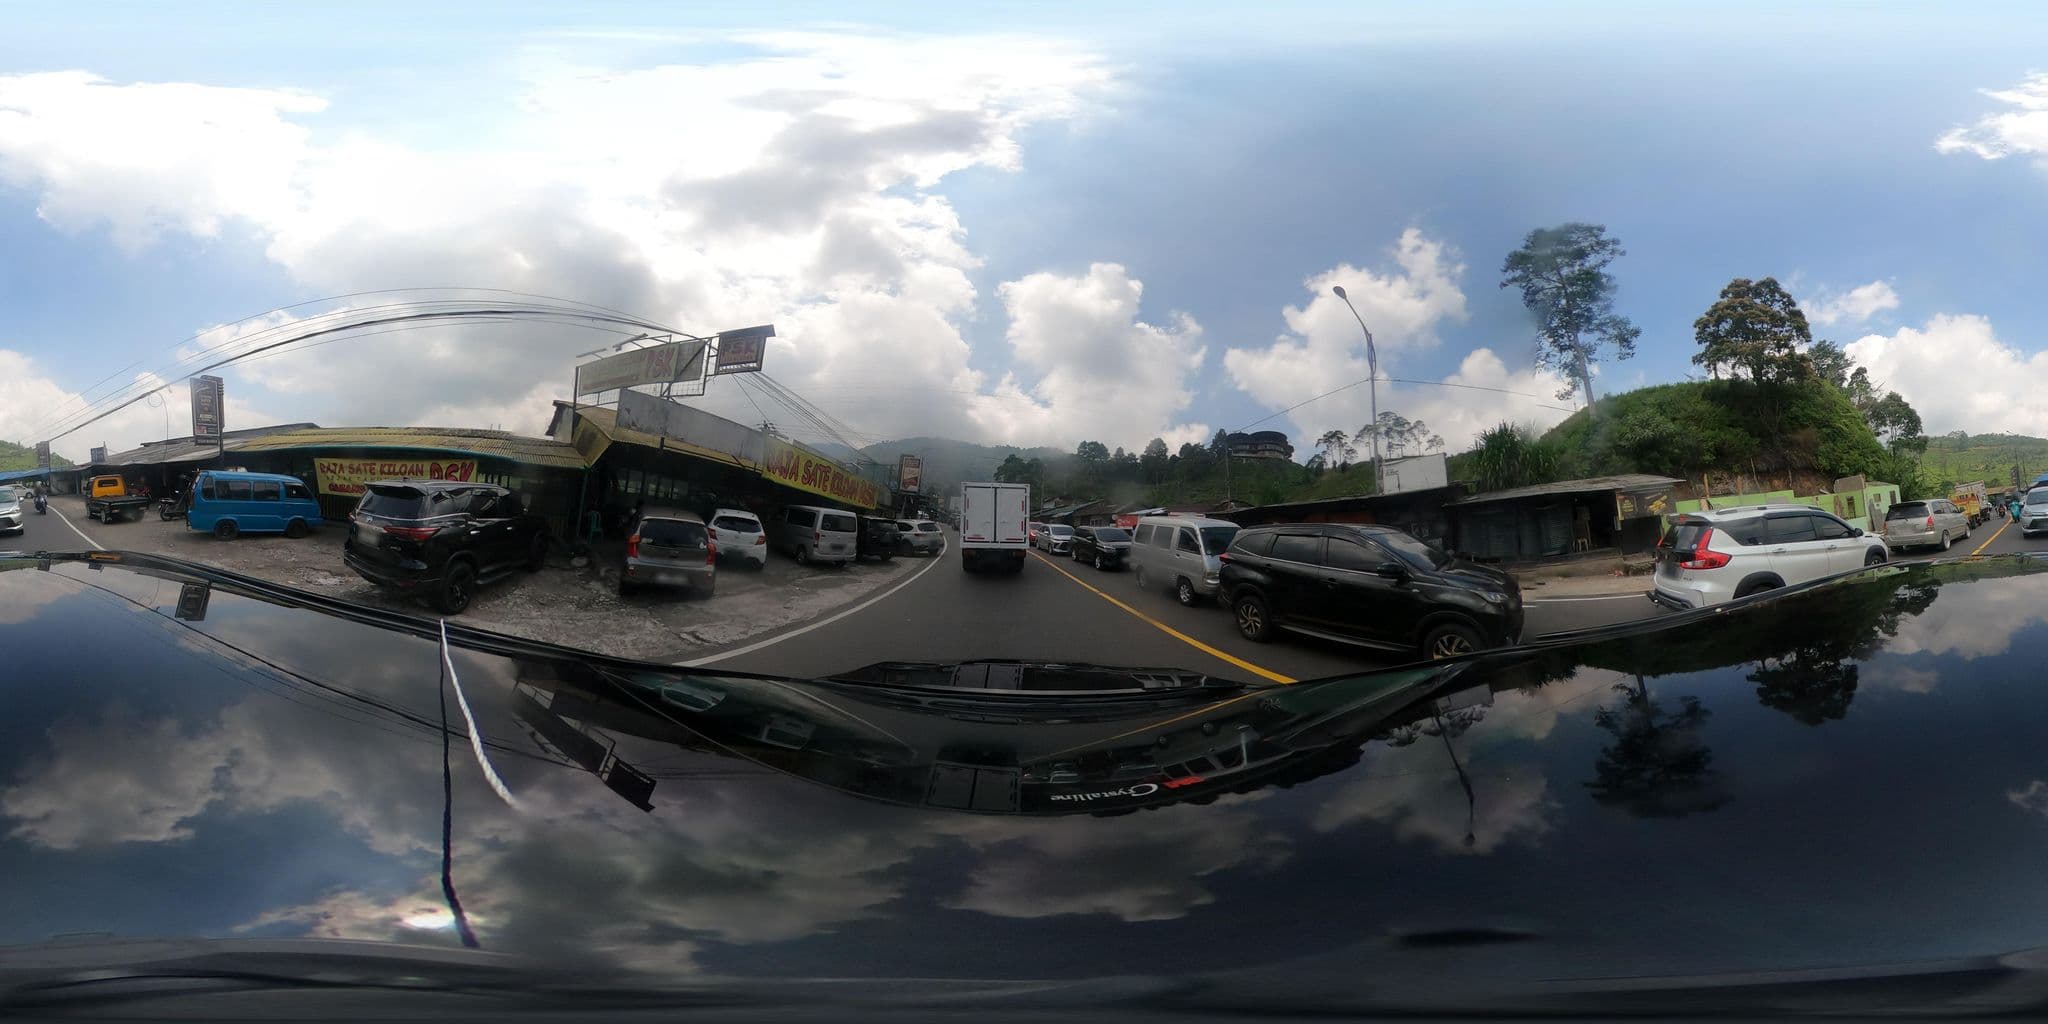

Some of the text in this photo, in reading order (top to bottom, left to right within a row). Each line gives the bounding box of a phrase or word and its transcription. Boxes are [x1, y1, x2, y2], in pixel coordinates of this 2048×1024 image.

[320, 463, 345, 475] RAJA
[348, 463, 376, 475] SATE
[380, 464, 424, 477] KILOAN
[802, 460, 831, 492] SATE
[1050, 783, 1158, 801] Crystalline
